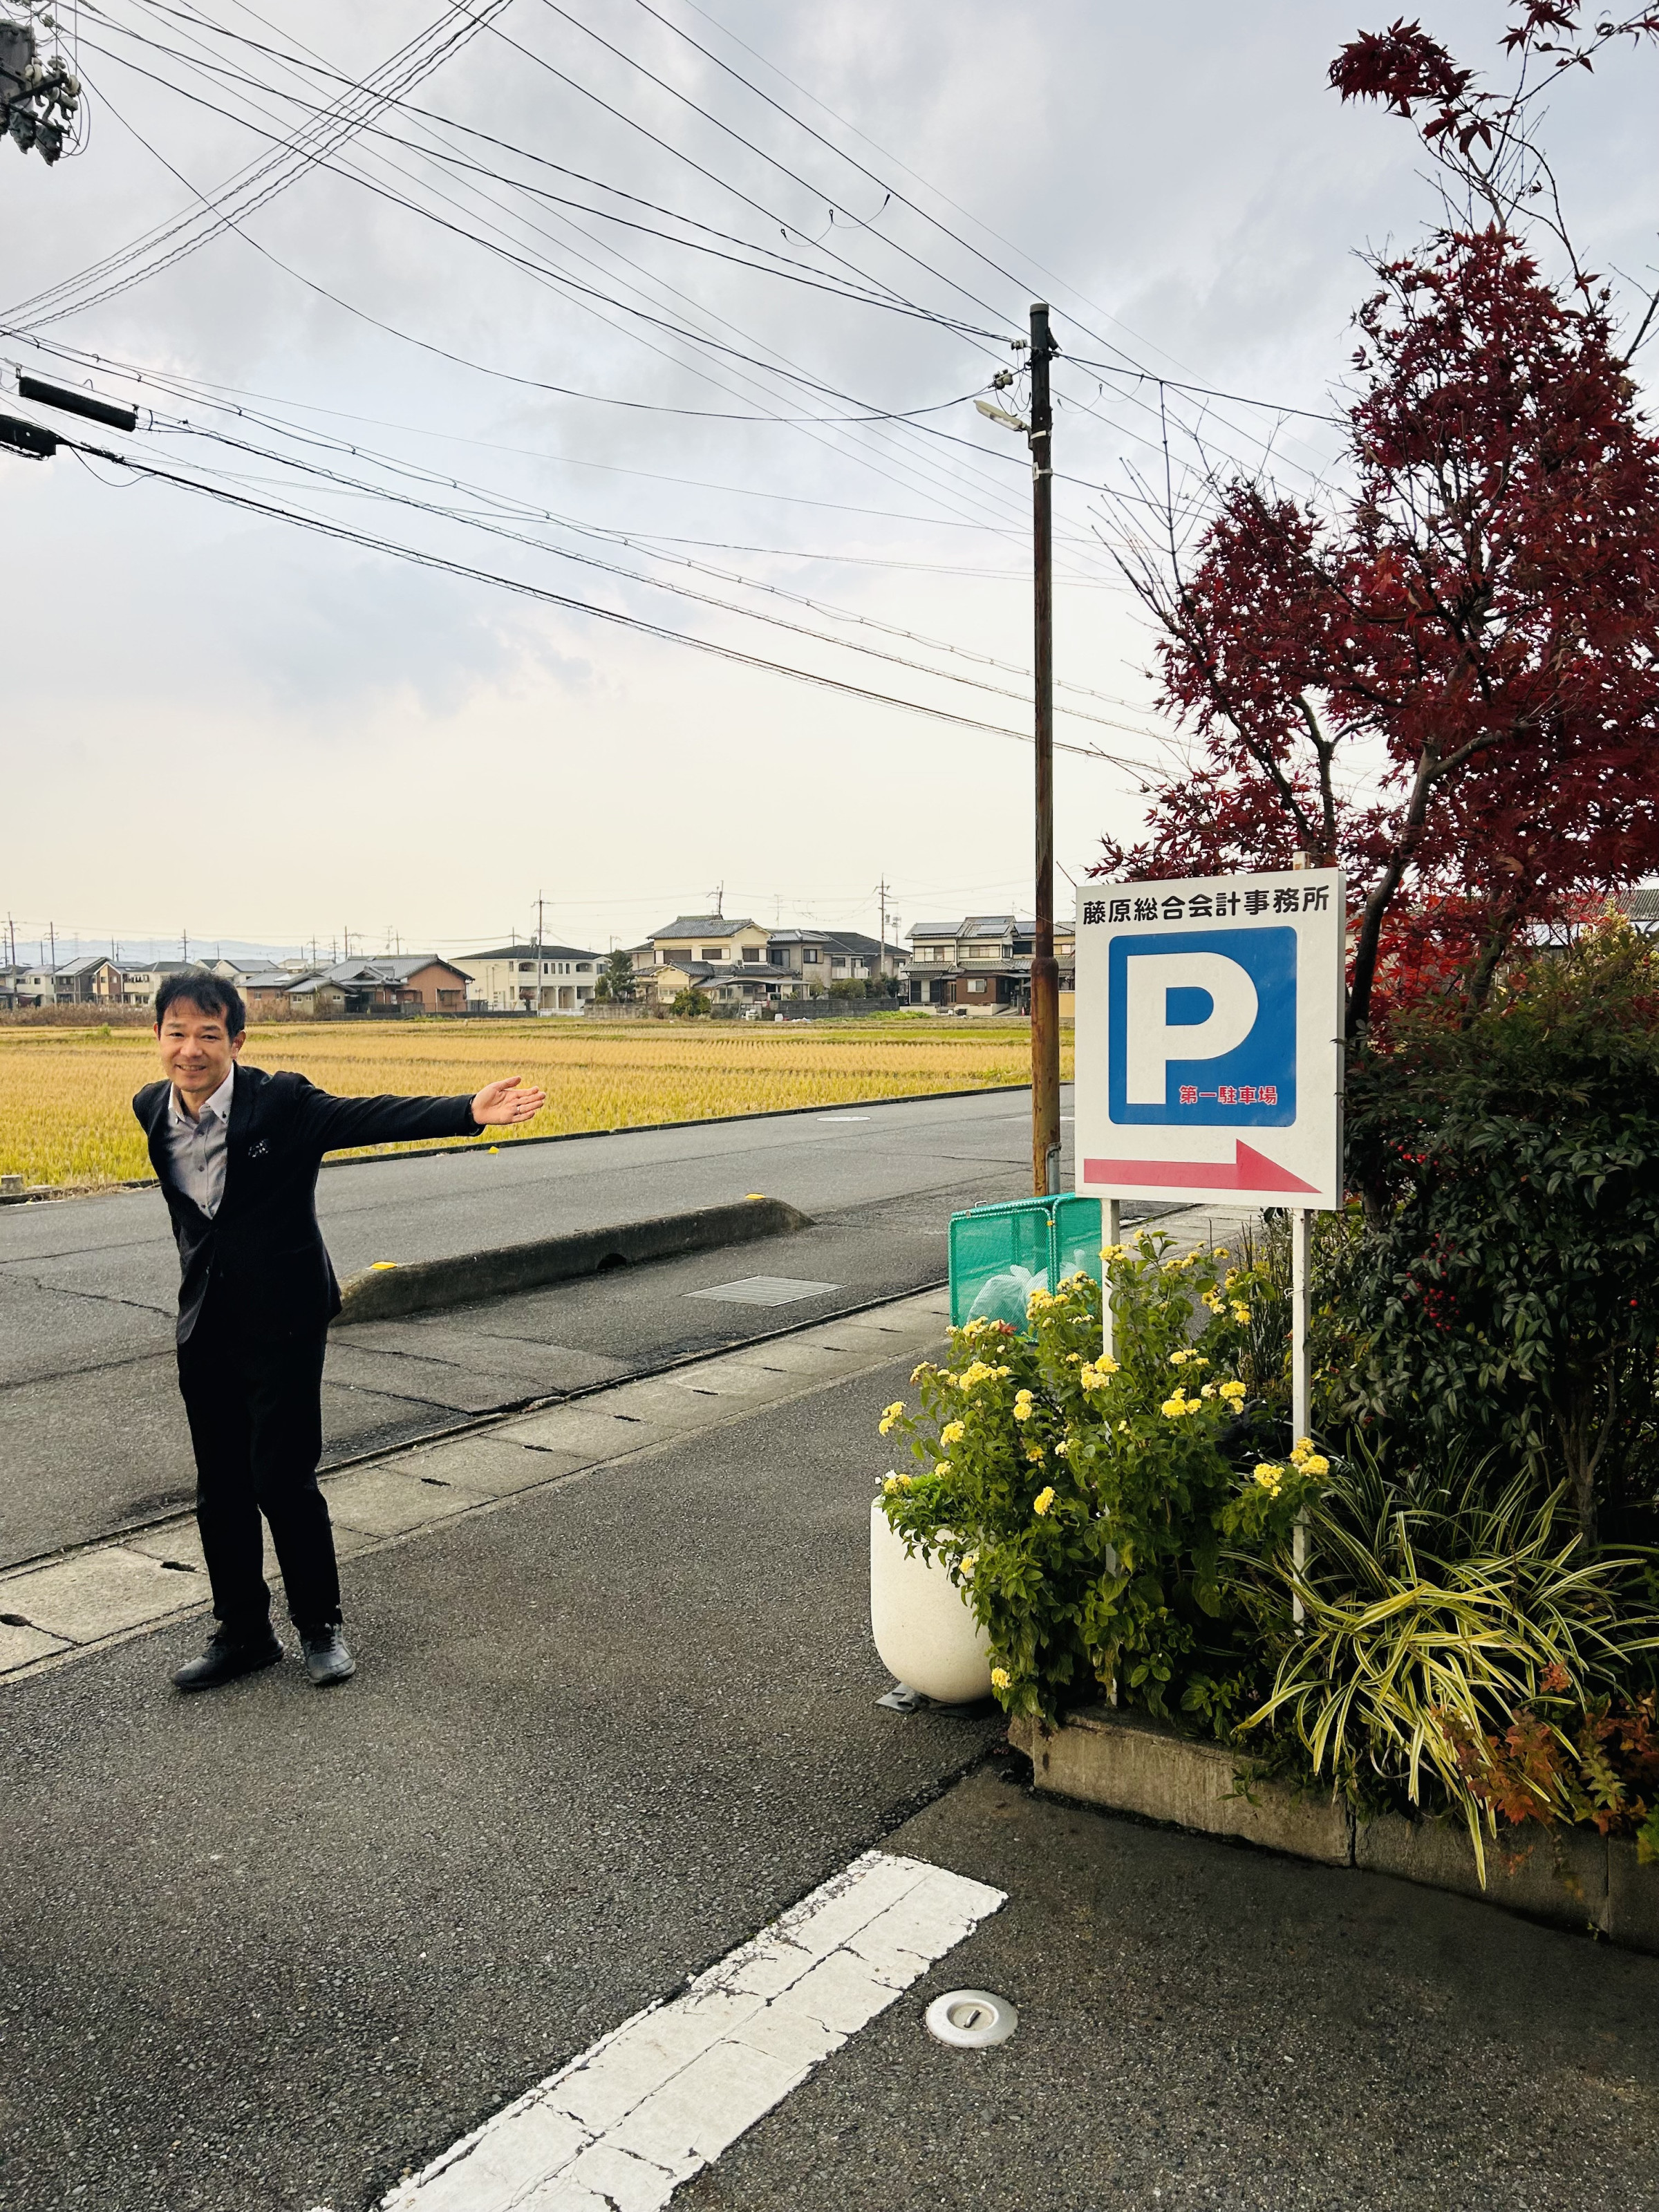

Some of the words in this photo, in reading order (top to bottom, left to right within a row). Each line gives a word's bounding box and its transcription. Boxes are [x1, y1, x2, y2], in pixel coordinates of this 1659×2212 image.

[1083, 885, 1329, 925] 藤原総合会計事務所
[1126, 952, 1258, 1105] P
[1179, 1085, 1277, 1105] 第一駐車場
